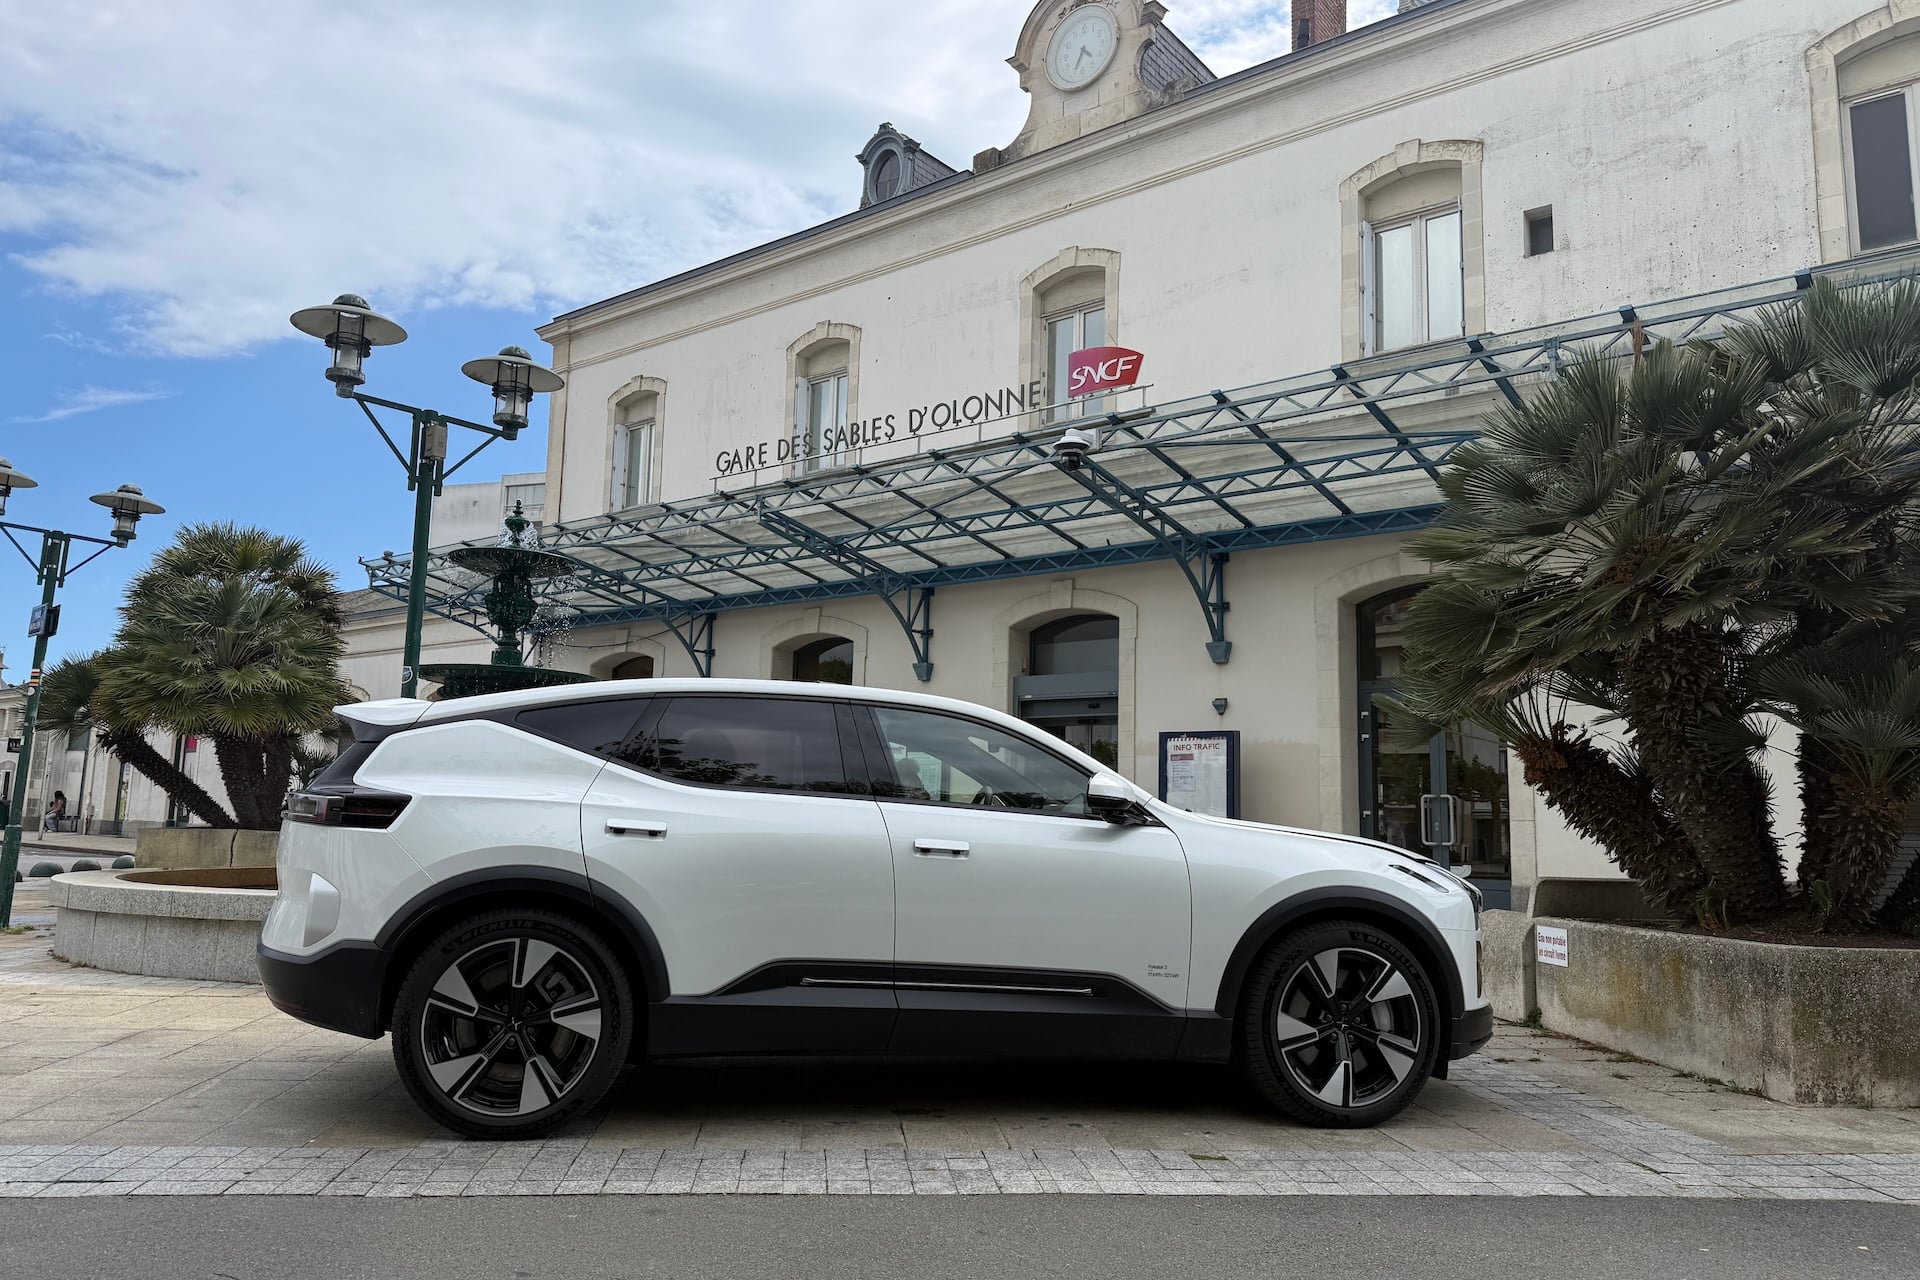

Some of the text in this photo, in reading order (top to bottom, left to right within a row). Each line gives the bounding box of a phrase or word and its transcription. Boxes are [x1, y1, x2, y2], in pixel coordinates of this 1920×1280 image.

[1069, 355, 1138, 391] SNCF
[716, 380, 1041, 474] GARE DES SABLES D'OLONNE
[1173, 744, 1192, 752] INFO
[1552, 936, 1566, 947] potable
[1544, 946, 1555, 958] circuit
